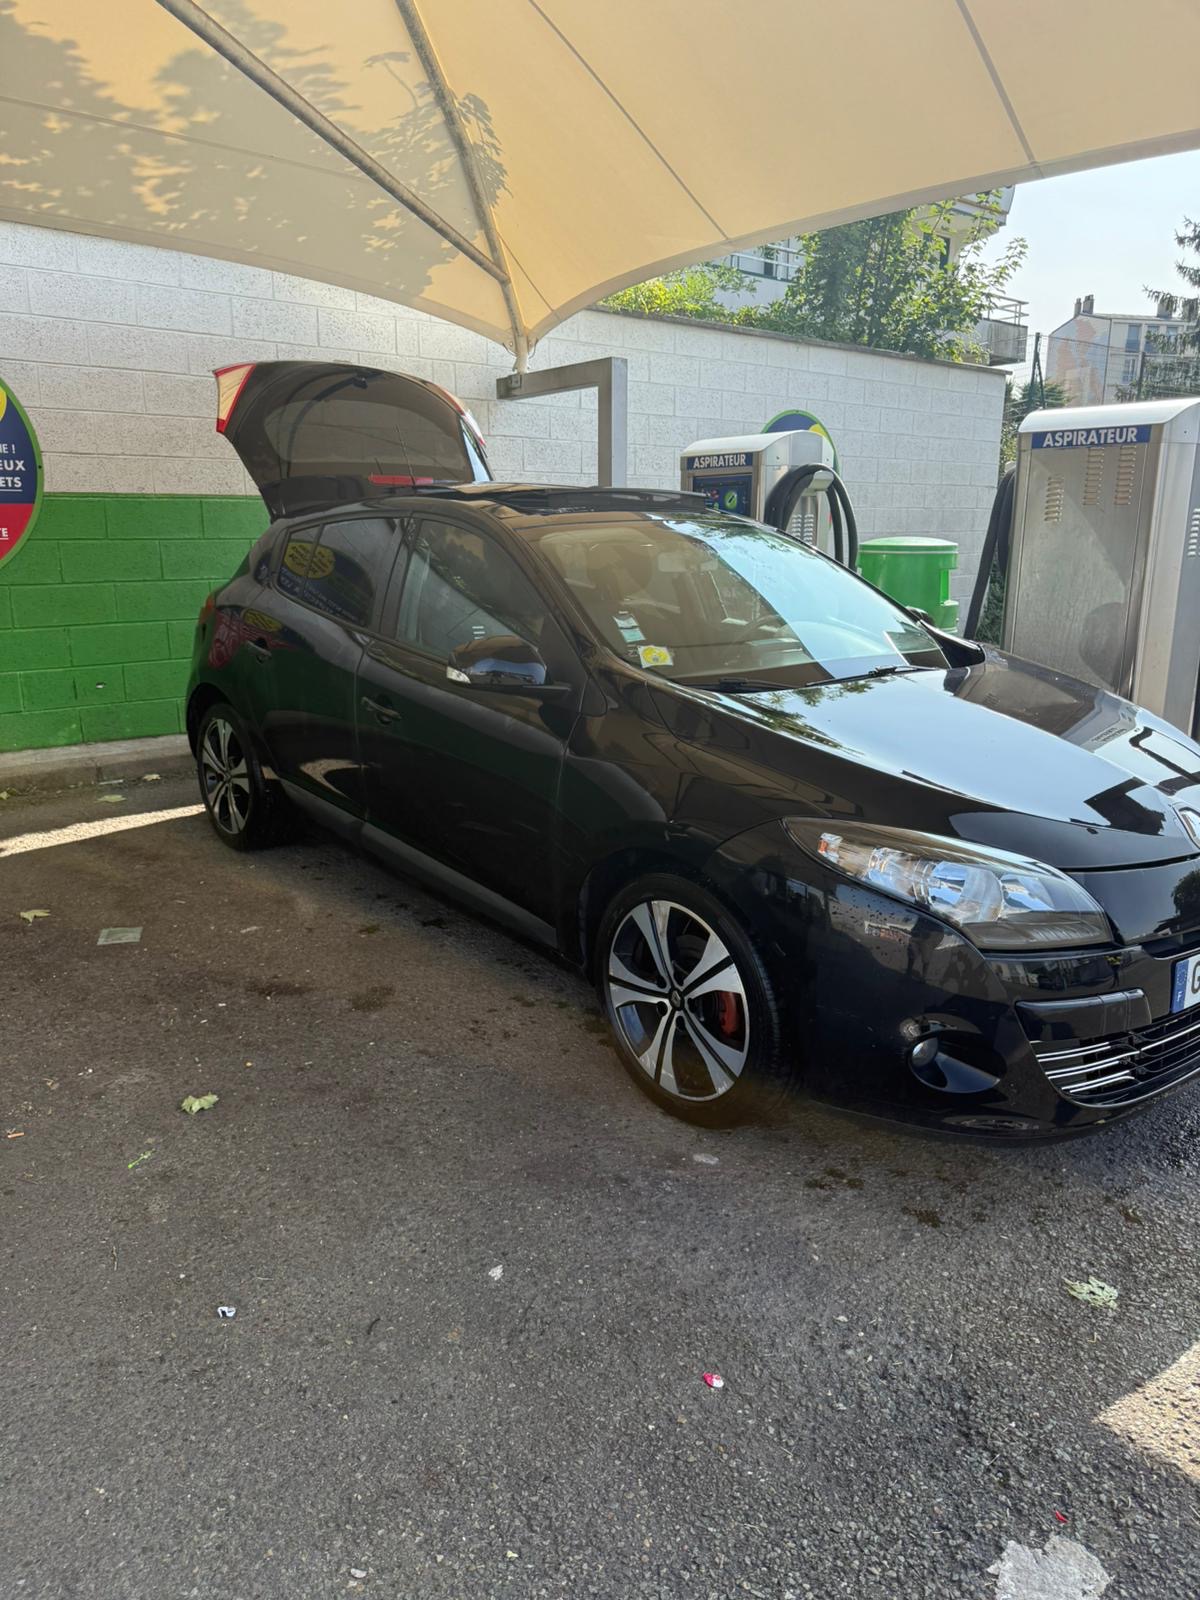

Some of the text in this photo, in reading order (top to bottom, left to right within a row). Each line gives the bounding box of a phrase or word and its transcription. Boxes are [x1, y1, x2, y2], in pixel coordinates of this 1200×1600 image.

[1043, 427, 1138, 448] ASPIRATEUR
[693, 454, 747, 469] ASPIRATEUR
[0, 527, 8, 537] E
